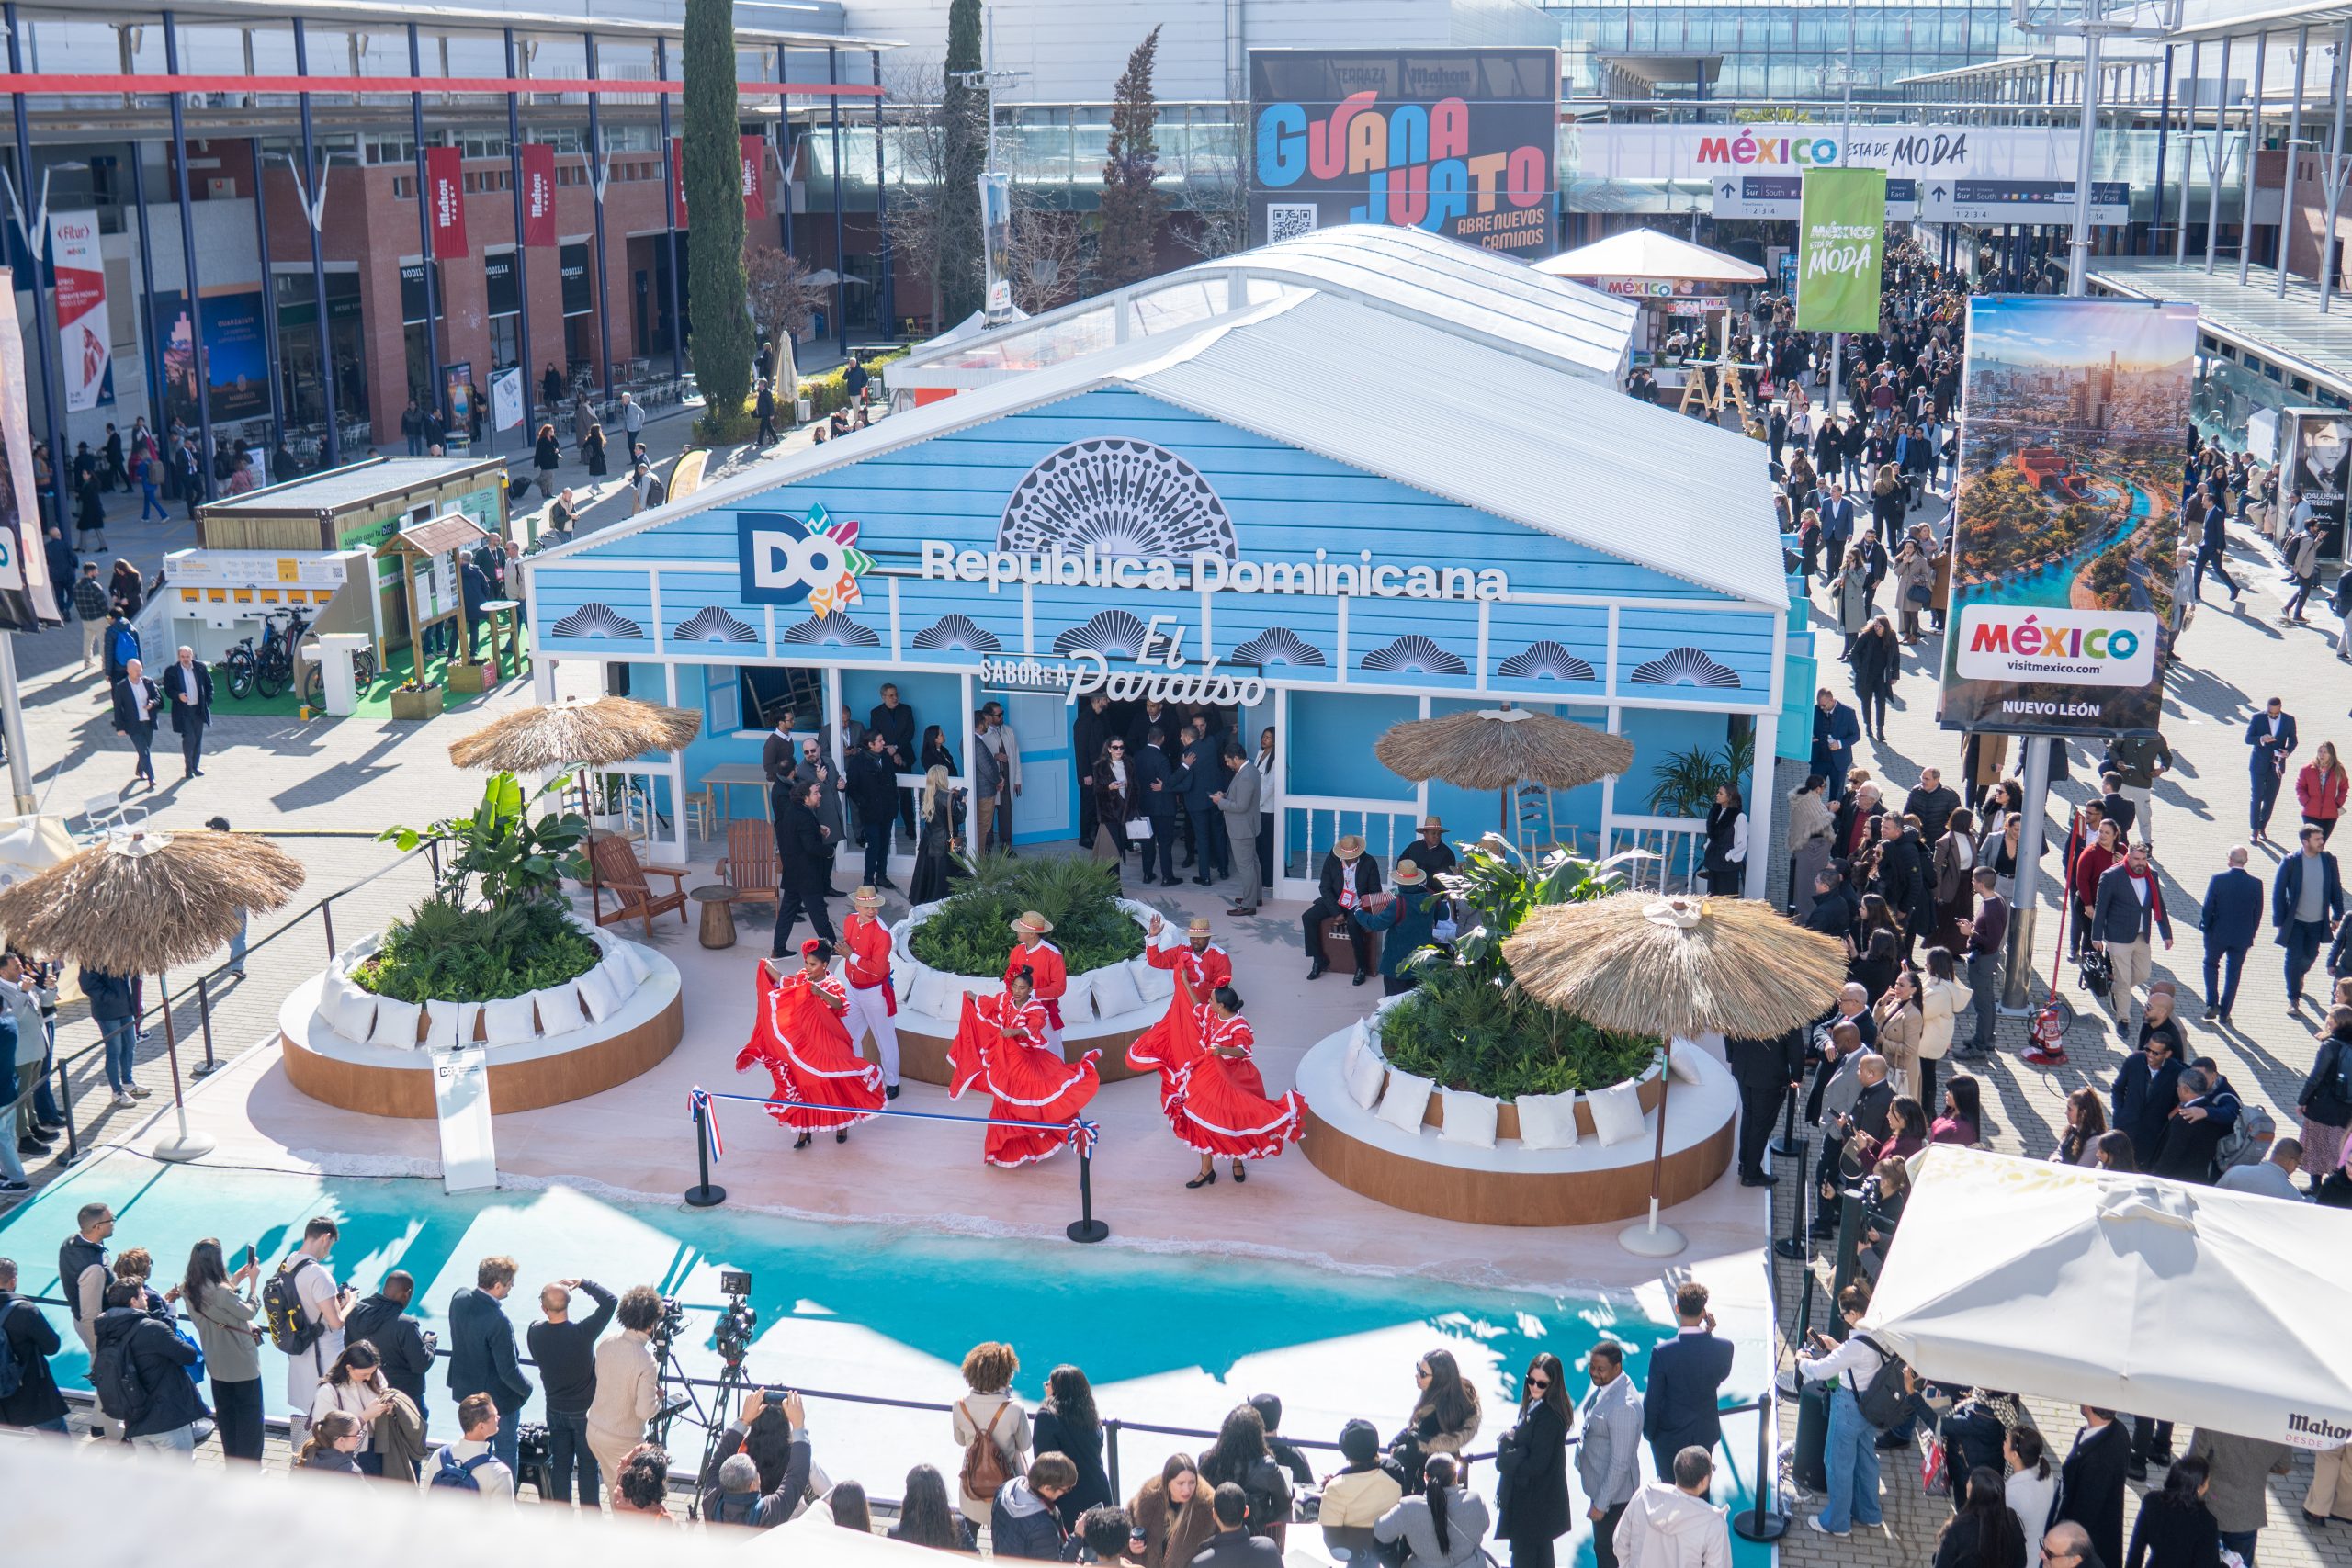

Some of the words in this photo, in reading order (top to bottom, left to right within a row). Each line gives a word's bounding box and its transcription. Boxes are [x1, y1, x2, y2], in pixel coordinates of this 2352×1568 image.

[1336, 68, 1387, 84] TERRAZA
[1411, 66, 1470, 84] Mahou
[1875, 142, 1889, 157] DE
[1892, 133, 1967, 166] MODA
[438, 179, 450, 227] Mahou
[532, 174, 542, 217] Mahou
[1457, 215, 1492, 235] ABRE
[1494, 208, 1544, 231] NUEVOS
[1482, 228, 1544, 251] CAMINOS
[486, 265, 509, 275] RODILLA
[561, 266, 583, 276] RODILLA
[1807, 243, 1871, 279] MODA
[752, 530, 846, 589] DO
[922, 538, 1180, 594] República
[1193, 548, 1512, 602] Dominicana
[1136, 615, 1187, 670] El
[1065, 649, 1266, 707] Paraíso
[2007, 660, 2100, 674] visitmexico.com
[2002, 700, 2057, 716] NUEVO
[2059, 702, 2100, 717] LEÓN
[2285, 1434, 2323, 1448] DESDE
